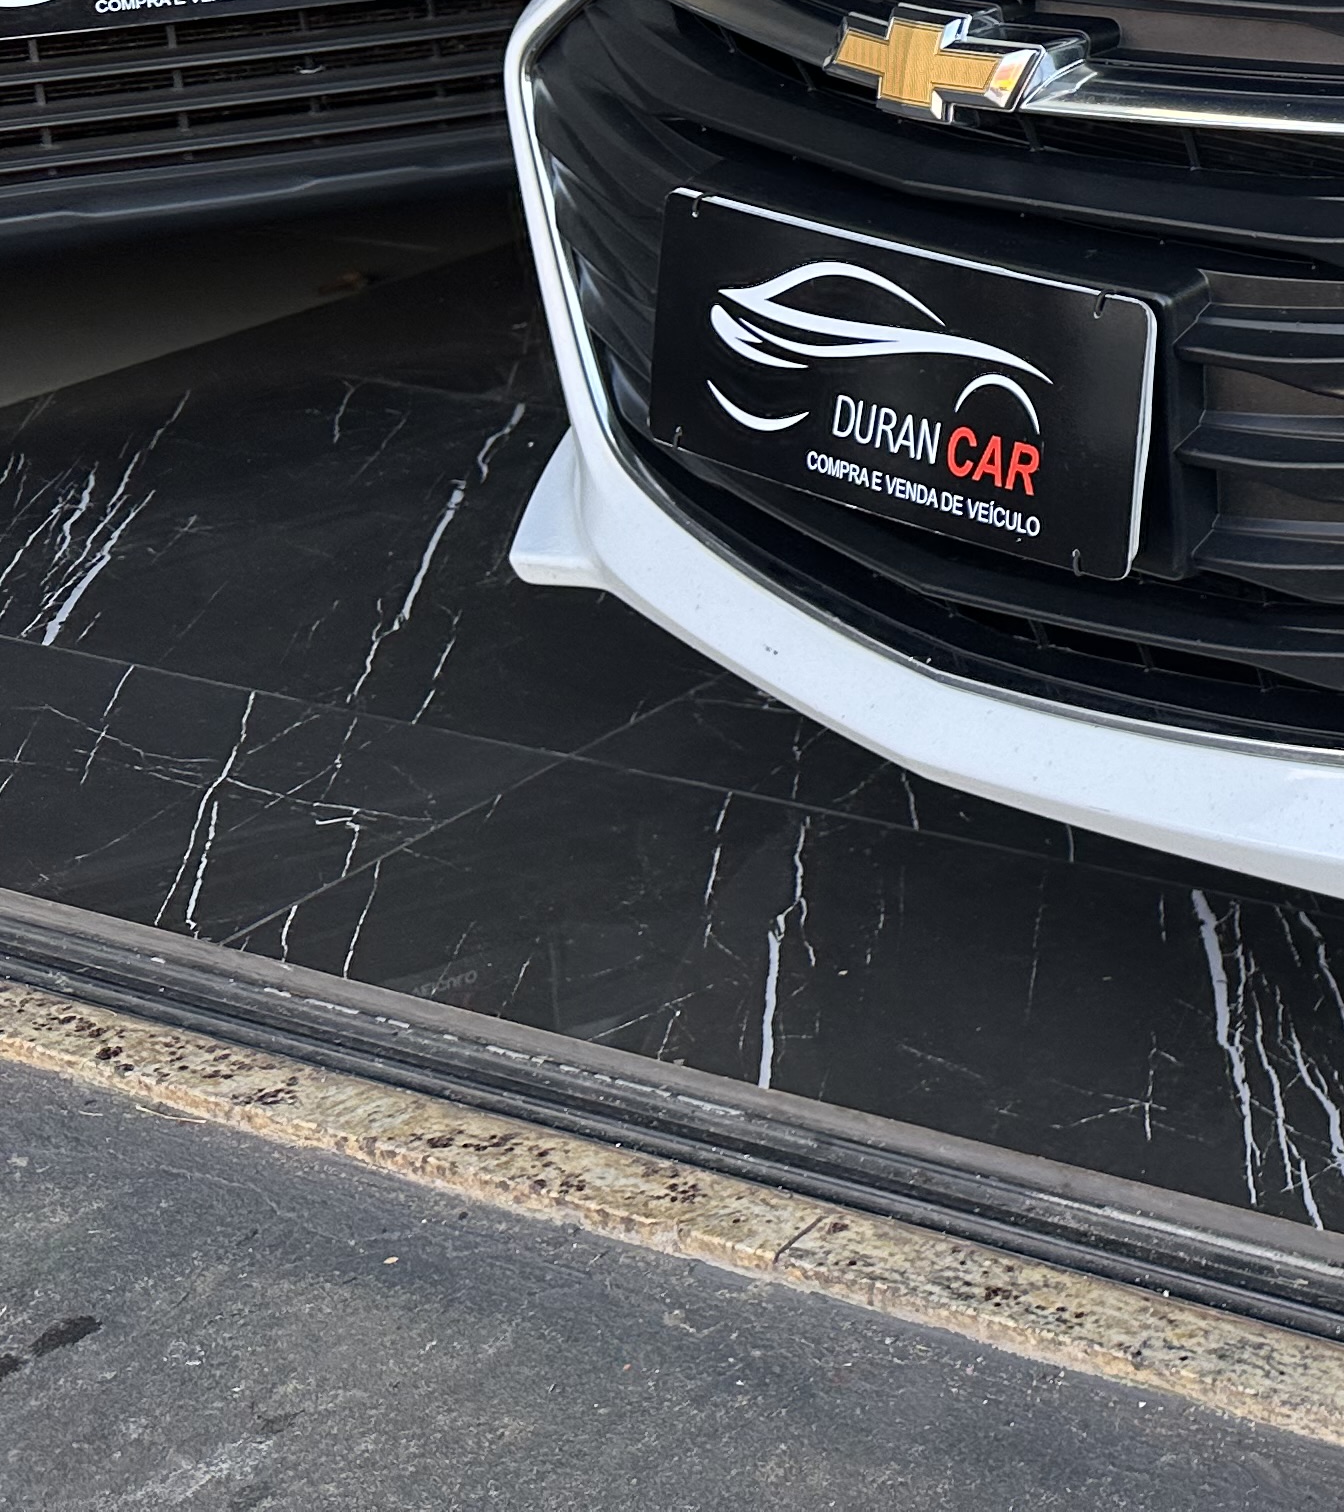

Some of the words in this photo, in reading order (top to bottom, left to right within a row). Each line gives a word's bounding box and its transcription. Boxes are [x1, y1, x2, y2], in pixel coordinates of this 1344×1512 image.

[832, 394, 942, 465] DURAN
[946, 426, 1041, 497] CAR
[806, 450, 870, 488] COMPRA
[871, 471, 883, 492] E
[885, 474, 939, 509] VENDA
[940, 491, 964, 516] DE
[966, 498, 1041, 537] VEÍCULO
